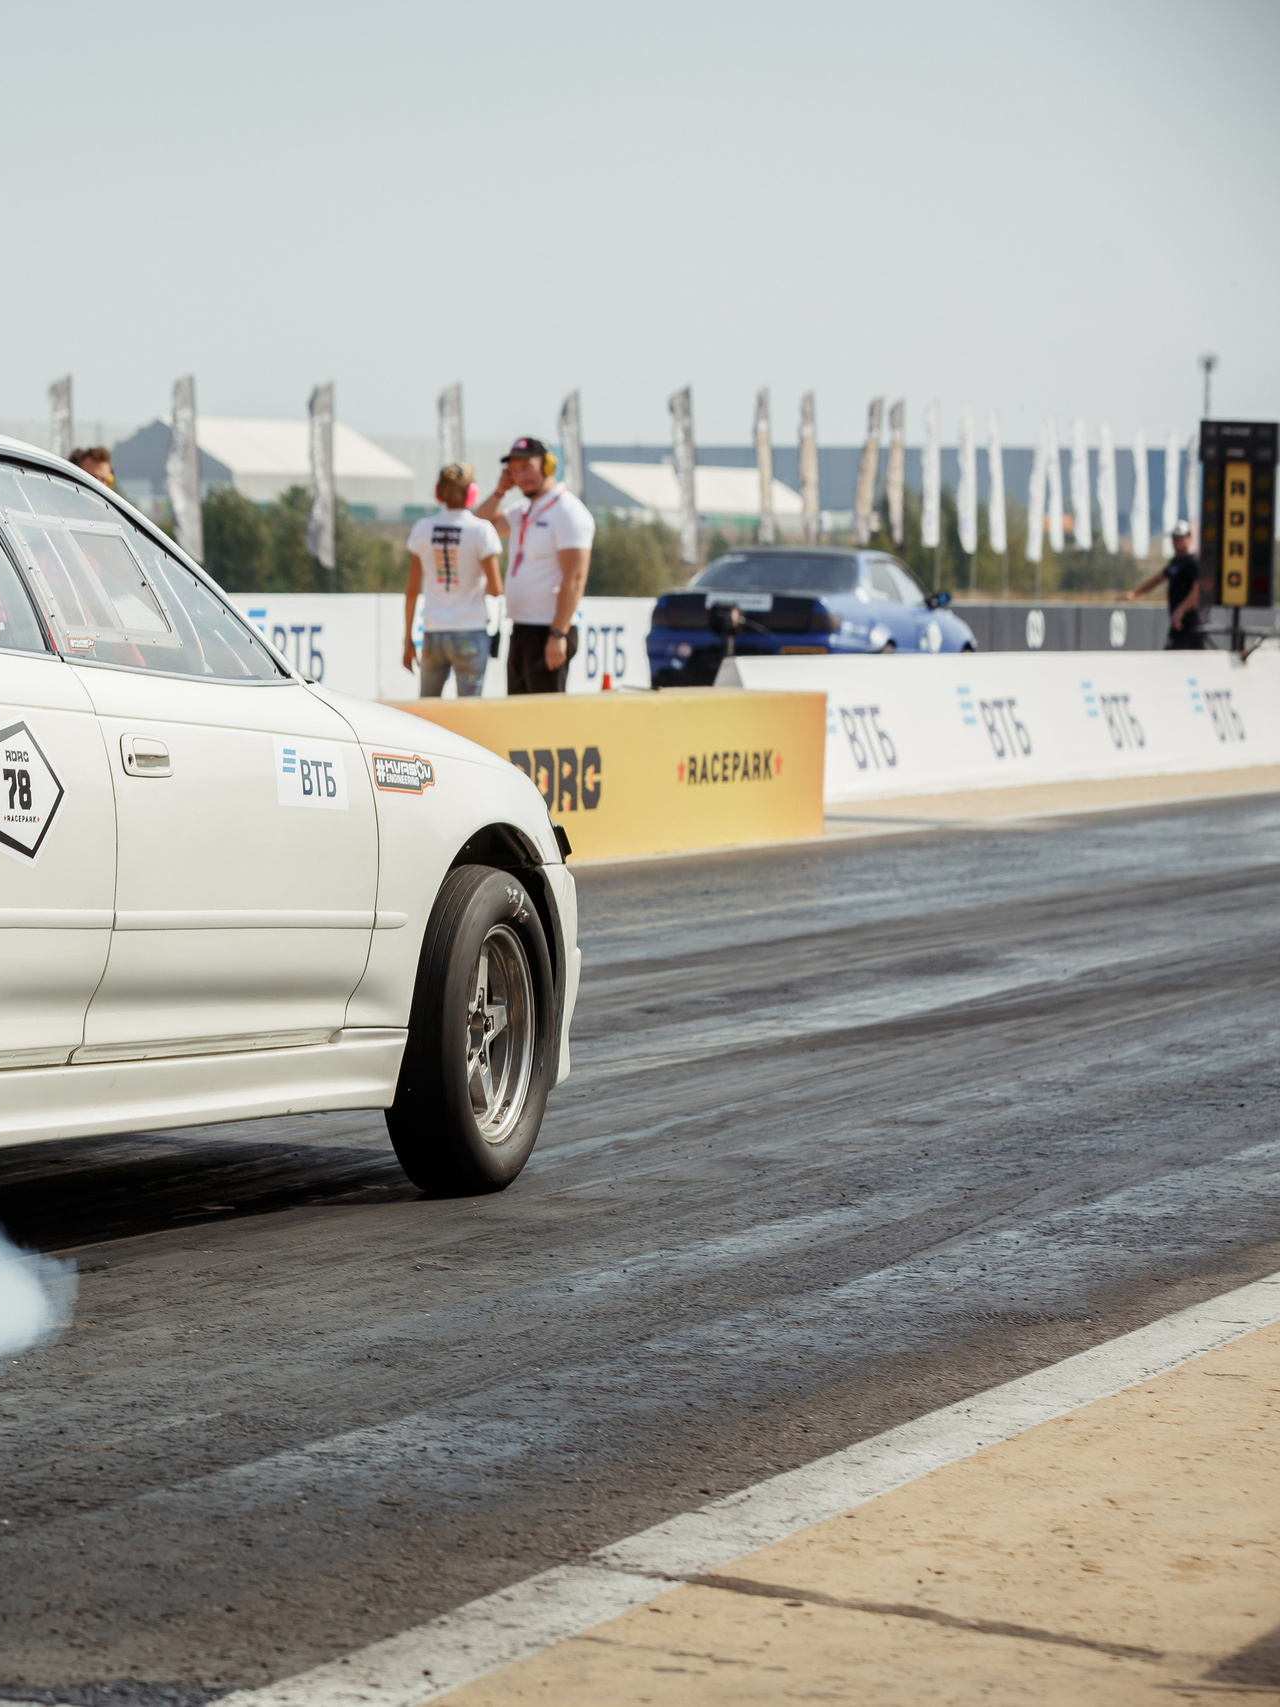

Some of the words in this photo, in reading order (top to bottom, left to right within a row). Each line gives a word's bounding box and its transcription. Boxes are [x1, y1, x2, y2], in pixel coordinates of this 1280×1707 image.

[587, 626, 625, 679] ВТБ
[840, 706, 897, 769] ВТБ
[979, 699, 1031, 758] ВТБ
[1101, 694, 1145, 749] ВТБ
[1205, 690, 1246, 742] ВТБ
[2, 768, 32, 810] 78
[300, 759, 337, 798] ВТБ
[386, 773, 420, 787] ENGINEERING
[687, 749, 773, 785] RACEPARK
[6, 815, 37, 824] RACEPARK
